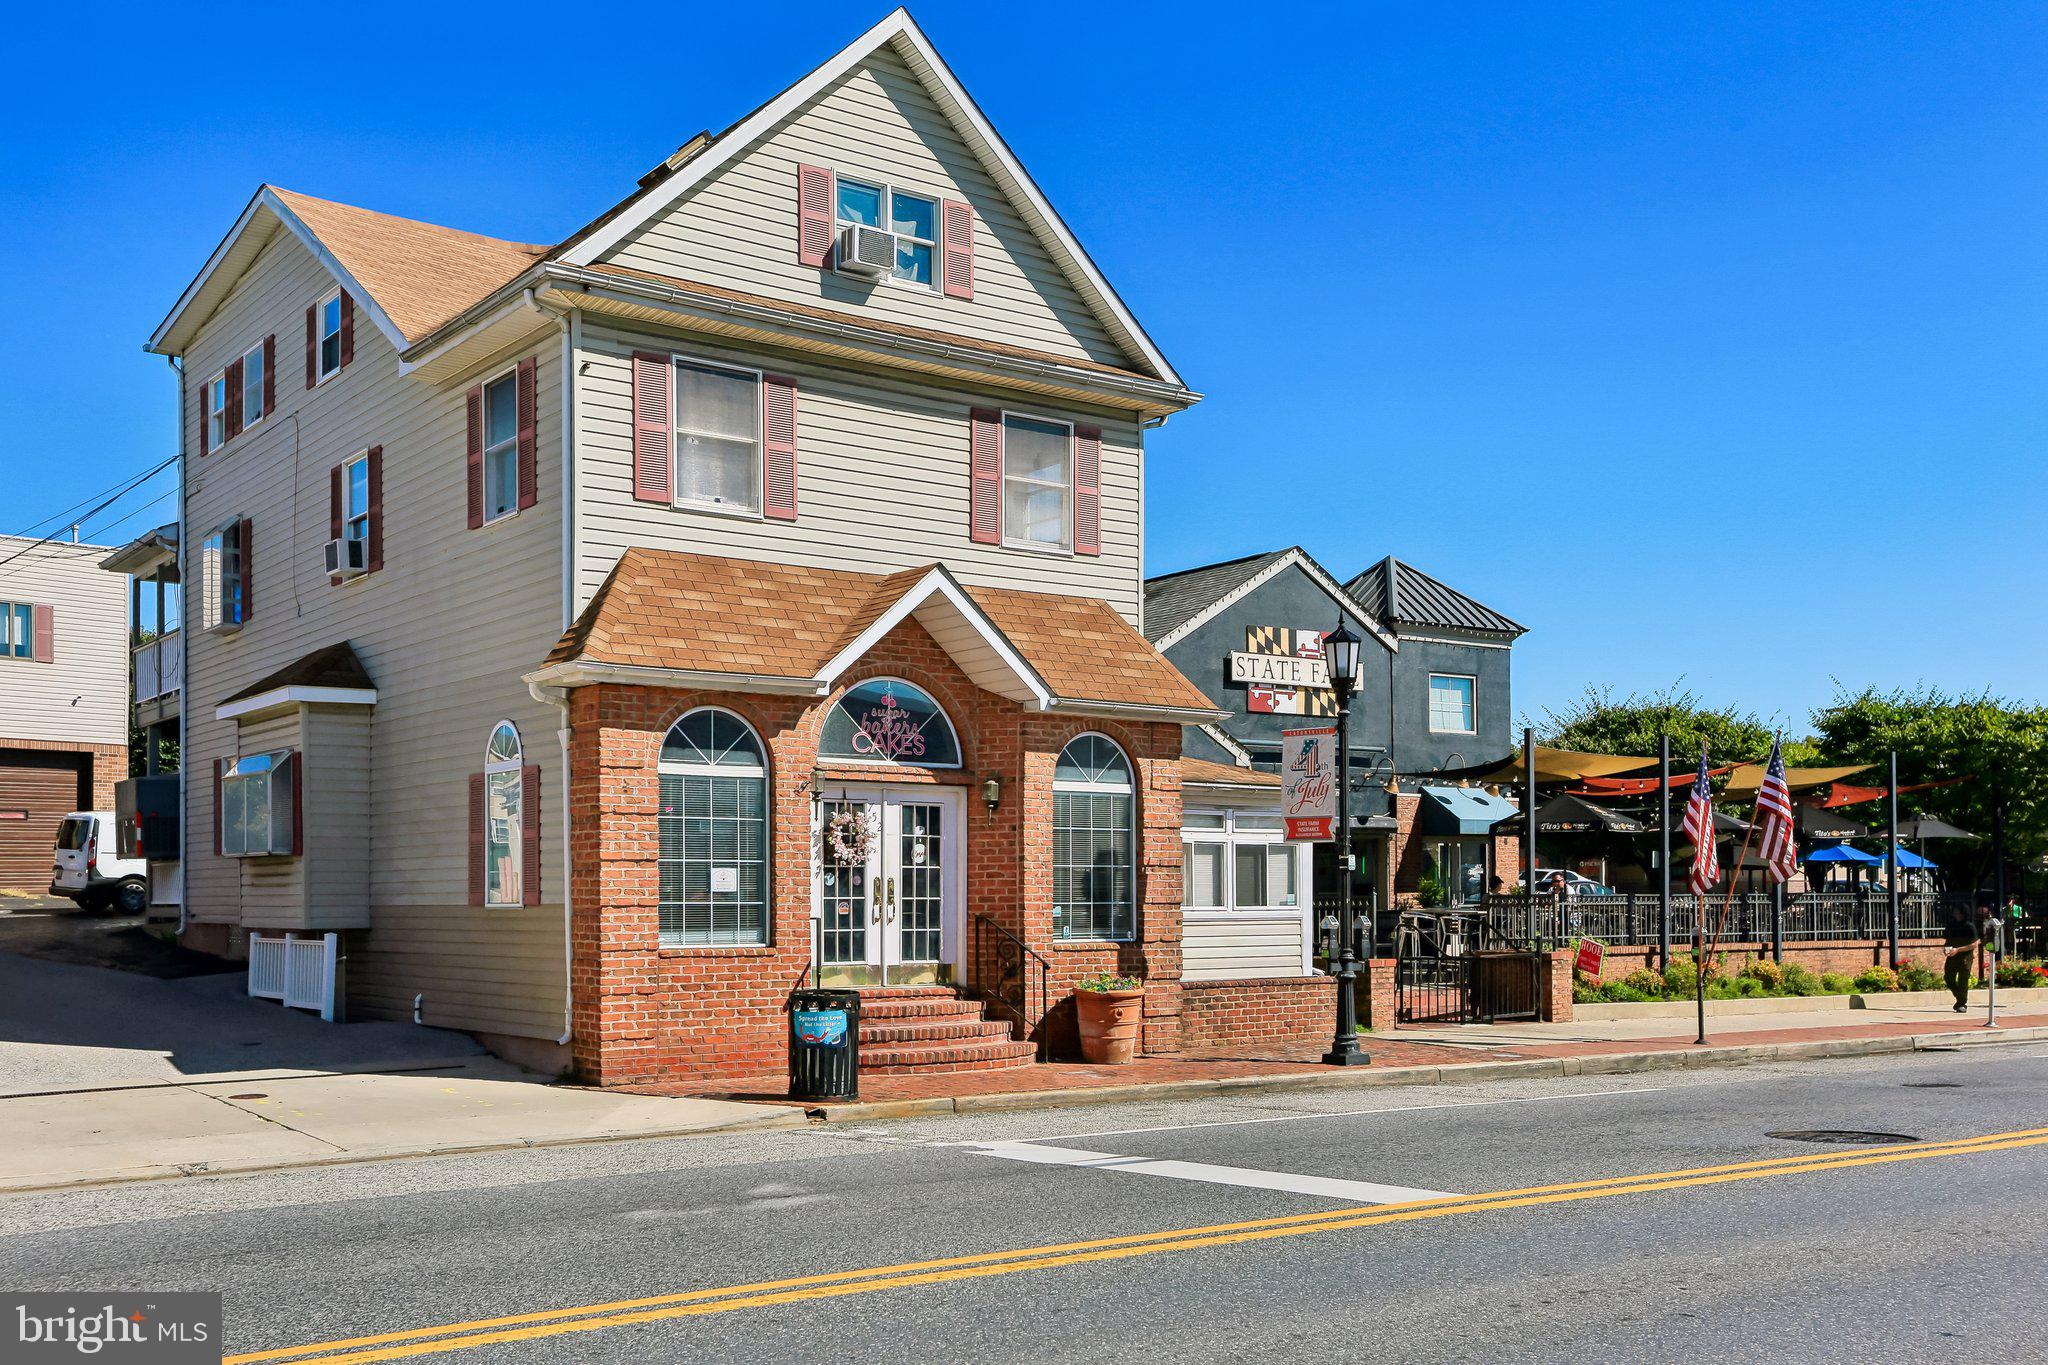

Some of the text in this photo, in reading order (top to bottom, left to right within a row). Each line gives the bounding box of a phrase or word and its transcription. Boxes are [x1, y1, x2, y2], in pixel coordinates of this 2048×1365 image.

[1236, 656, 1301, 681] STATE
[861, 712, 919, 735] bakers
[871, 707, 910, 720] sugar
[852, 731, 925, 756] CAKES
[1285, 772, 1332, 815] of July
[798, 1015, 818, 1023] Spread
